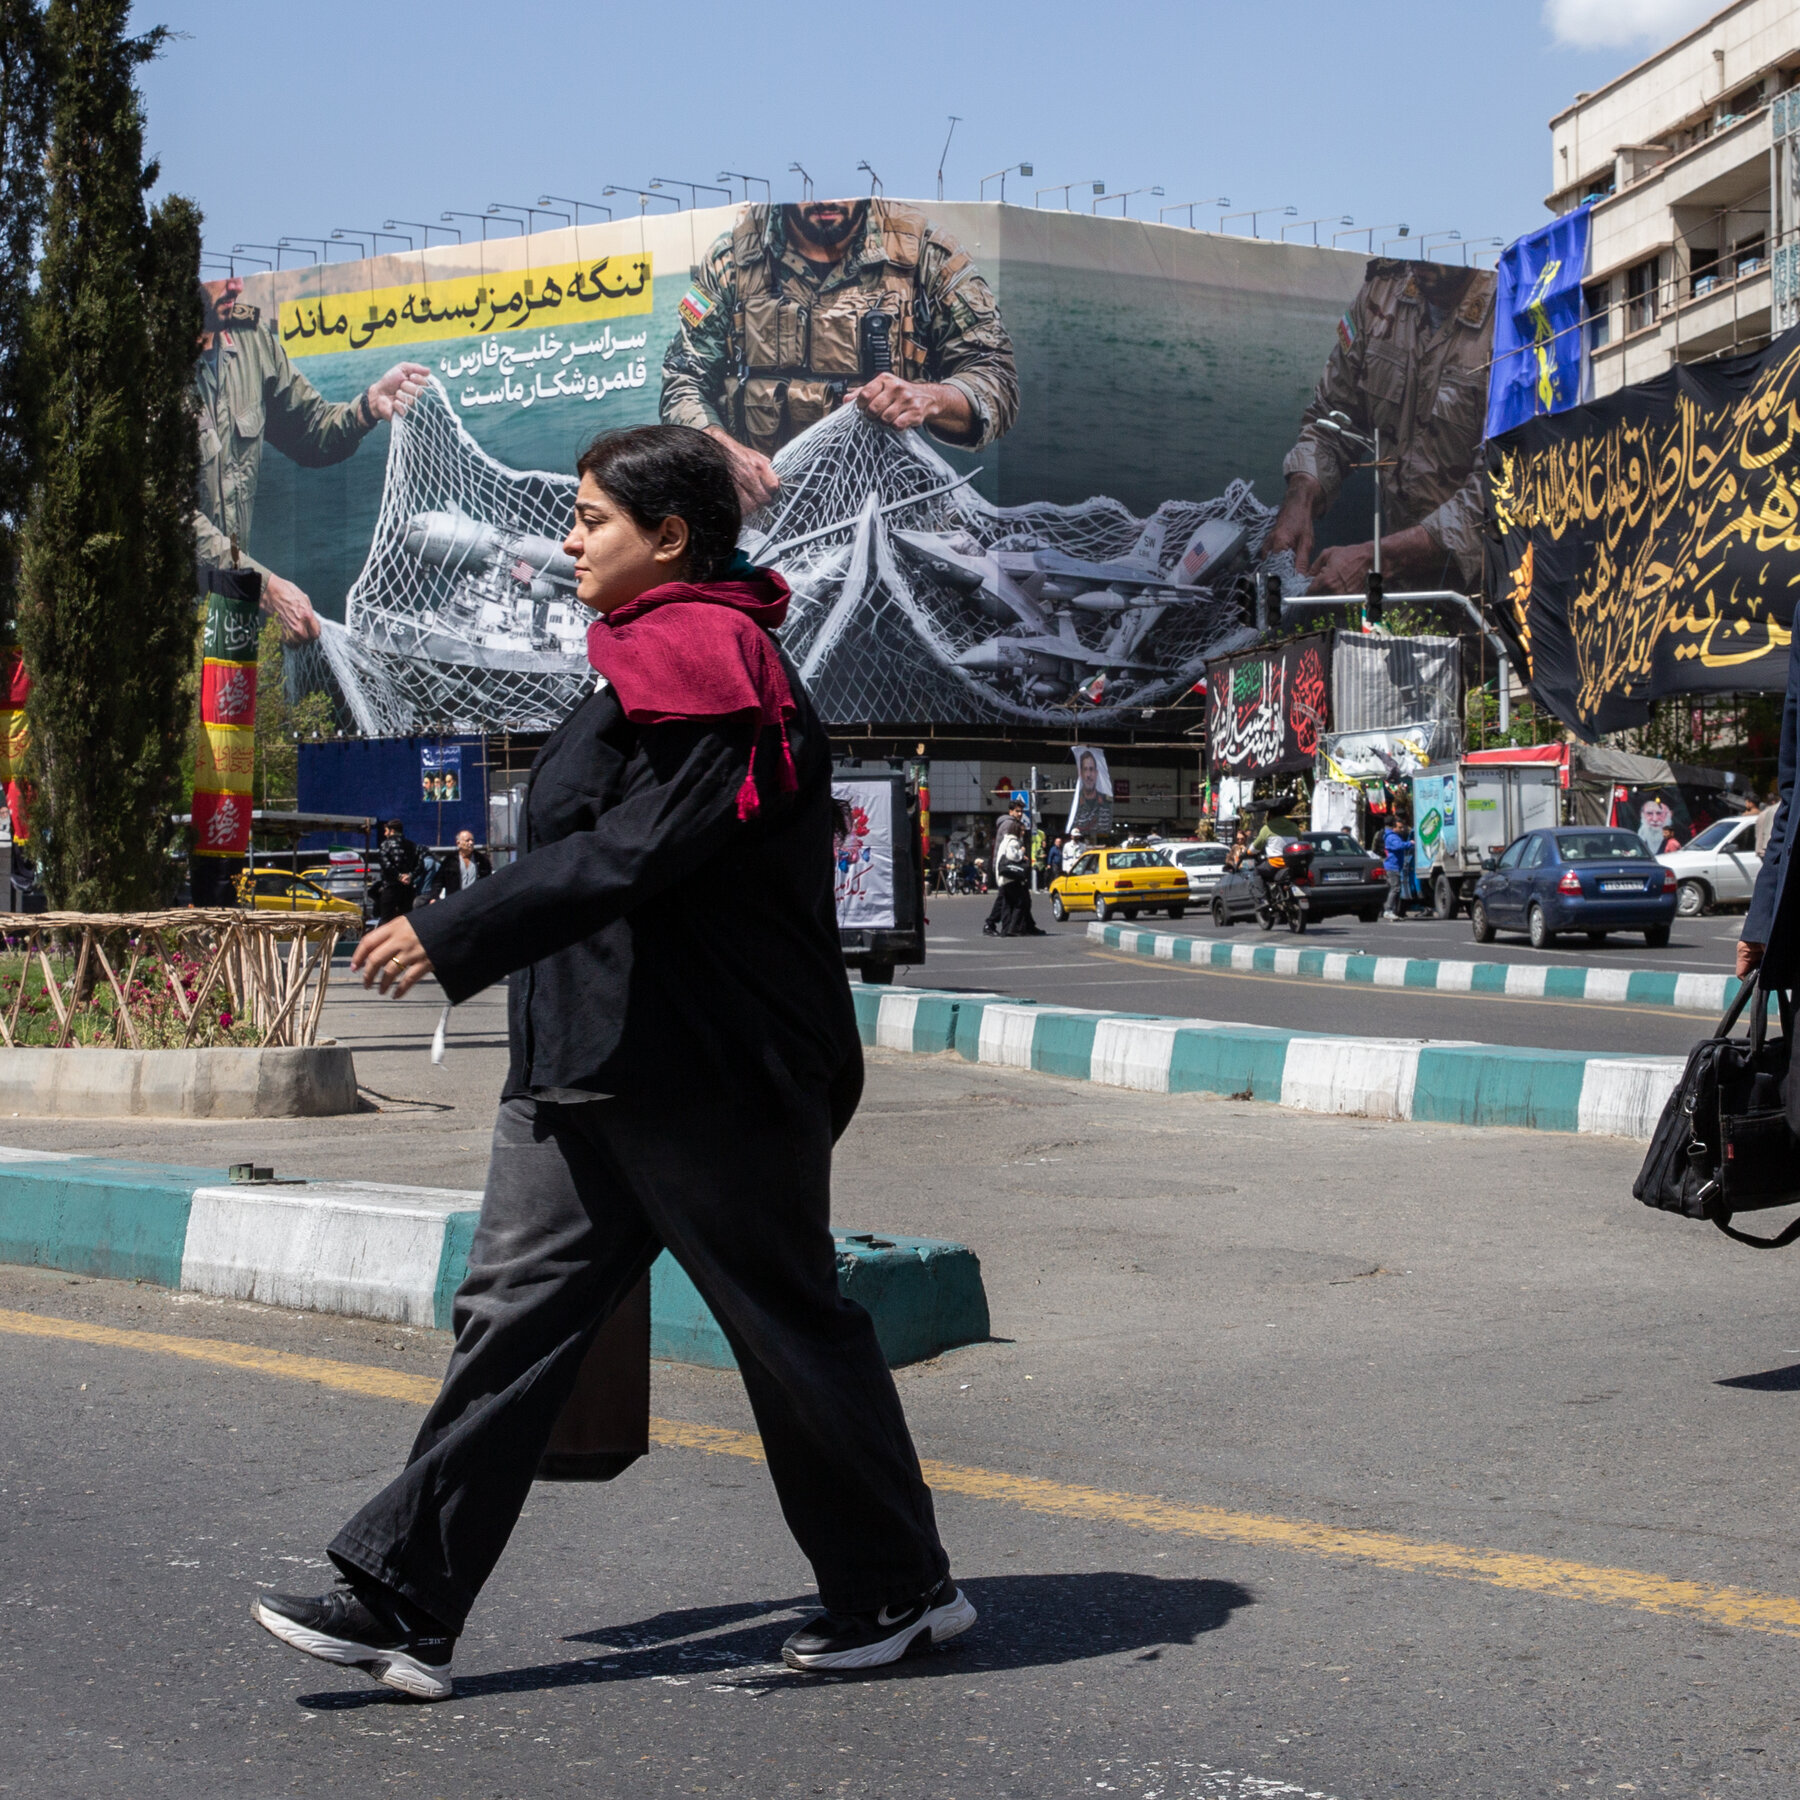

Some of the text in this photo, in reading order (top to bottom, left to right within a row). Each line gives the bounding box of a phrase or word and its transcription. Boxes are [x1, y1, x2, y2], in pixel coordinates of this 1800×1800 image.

[567, 256, 645, 303] تنگه
[401, 294, 480, 329] بسته
[478, 276, 563, 332] هرمز
[499, 333, 563, 375] خلیج
[560, 326, 647, 365] سراسر
[460, 356, 647, 408] قلمرو شکار ماست
